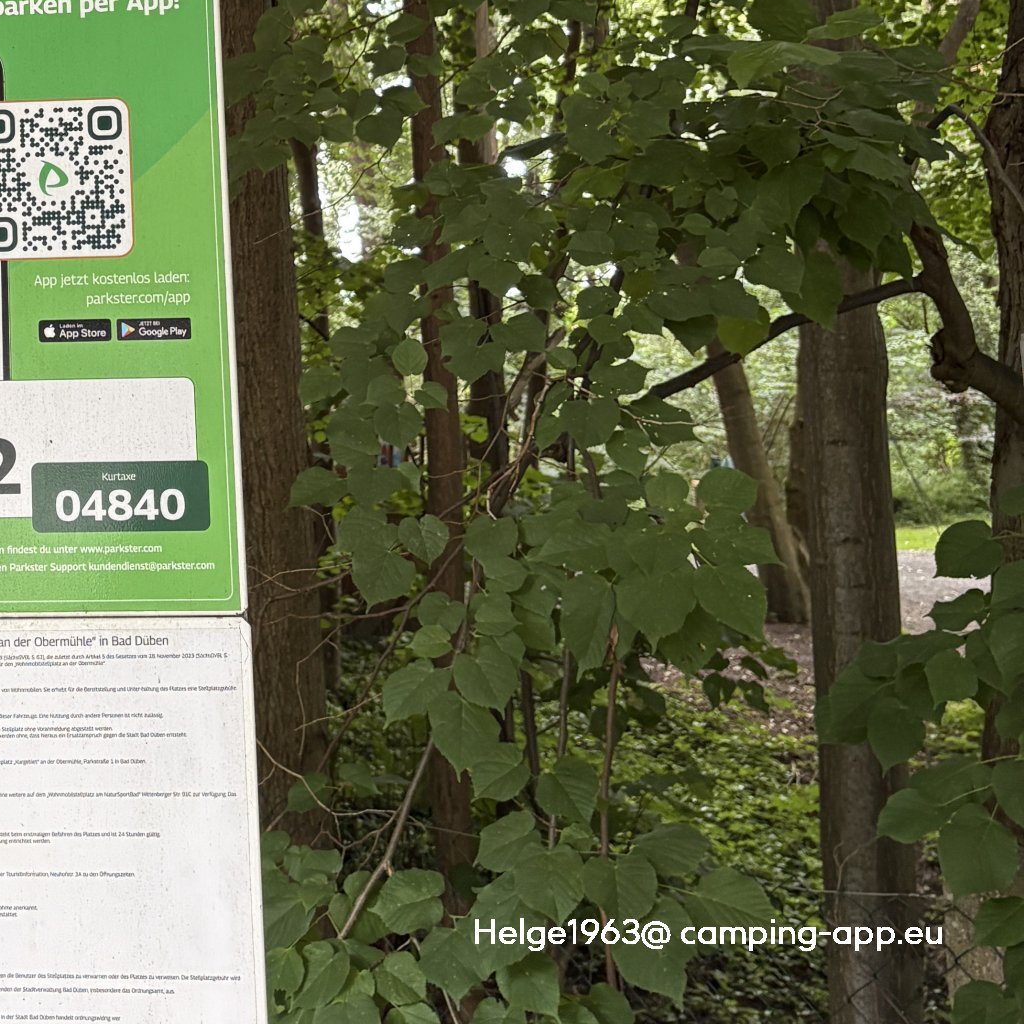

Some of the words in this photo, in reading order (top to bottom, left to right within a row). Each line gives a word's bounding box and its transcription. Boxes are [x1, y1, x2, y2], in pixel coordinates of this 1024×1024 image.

[34, 275, 57, 289] App
[60, 273, 88, 288] jetzt
[92, 272, 151, 285] kostenlos
[154, 271, 190, 283] laden:
[86, 291, 190, 308] parkster.com/app
[59, 329, 79, 339] App
[81, 329, 106, 337] Store
[139, 327, 168, 338] Google
[170, 326, 187, 337] Play
[102, 472, 136, 482] Kurtaxe
[55, 489, 186, 523] 04840
[7, 545, 37, 554] findest
[40, 545, 51, 554] du
[53, 545, 78, 554] unter
[80, 544, 162, 554] www.parkster.com
[9, 563, 47, 572] Parkster
[50, 562, 86, 572] Support
[88, 561, 215, 572] kundendienst@parkster.com
[13, 637, 31, 647] der
[99, 636, 109, 646] in
[111, 636, 132, 646] Bad
[136, 635, 169, 646] Düben
